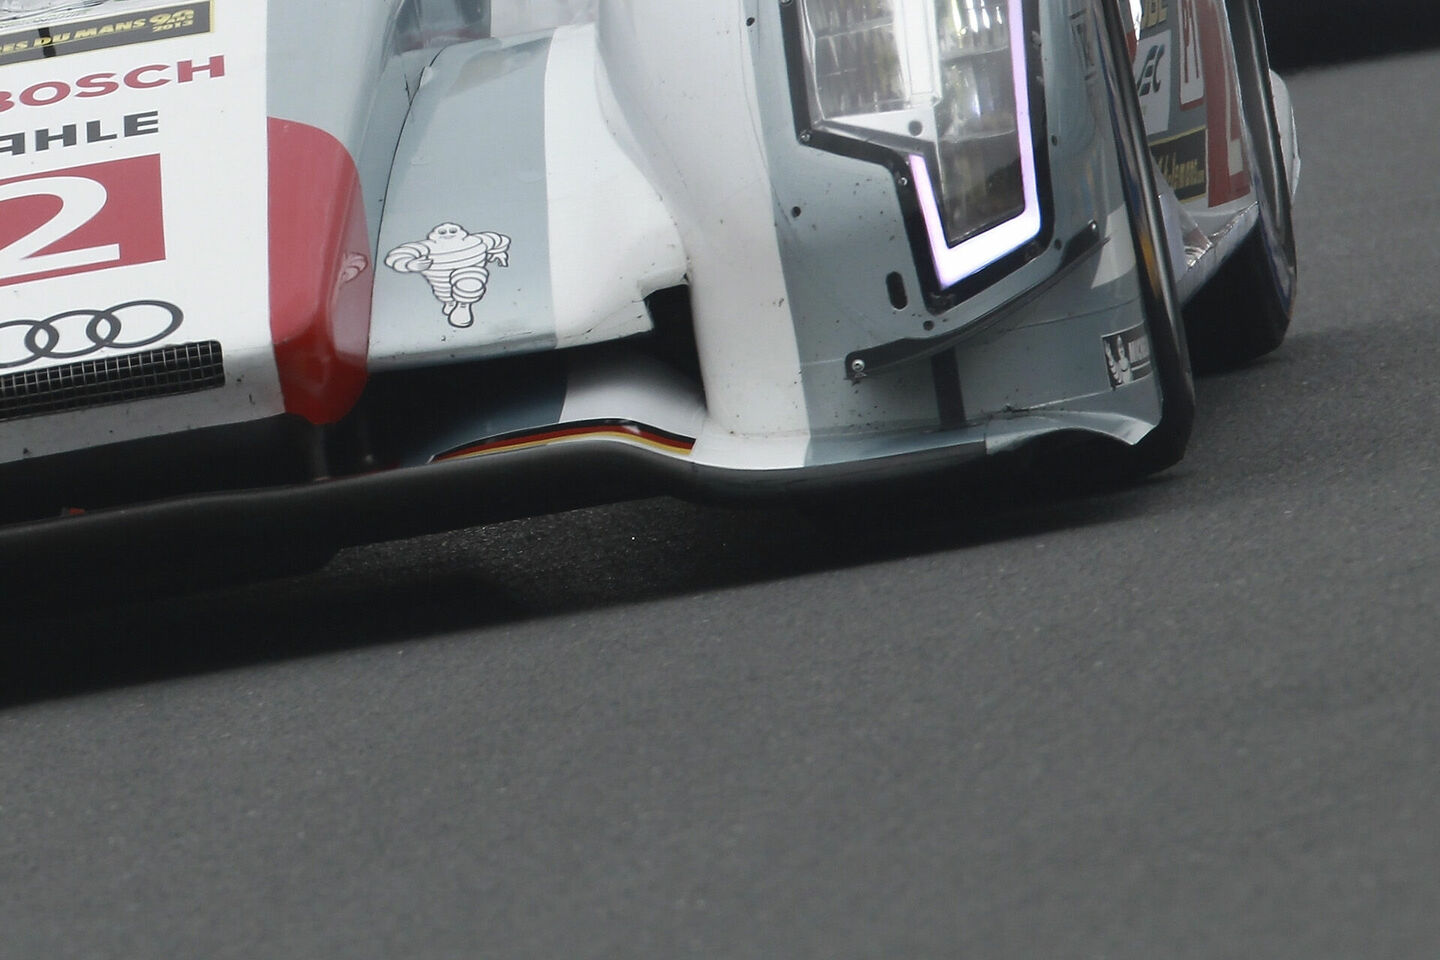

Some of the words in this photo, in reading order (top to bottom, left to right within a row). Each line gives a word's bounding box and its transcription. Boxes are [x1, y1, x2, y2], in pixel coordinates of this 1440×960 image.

[34, 32, 71, 47] DU
[74, 18, 147, 39] MANS
[1137, 43, 1166, 98] EC
